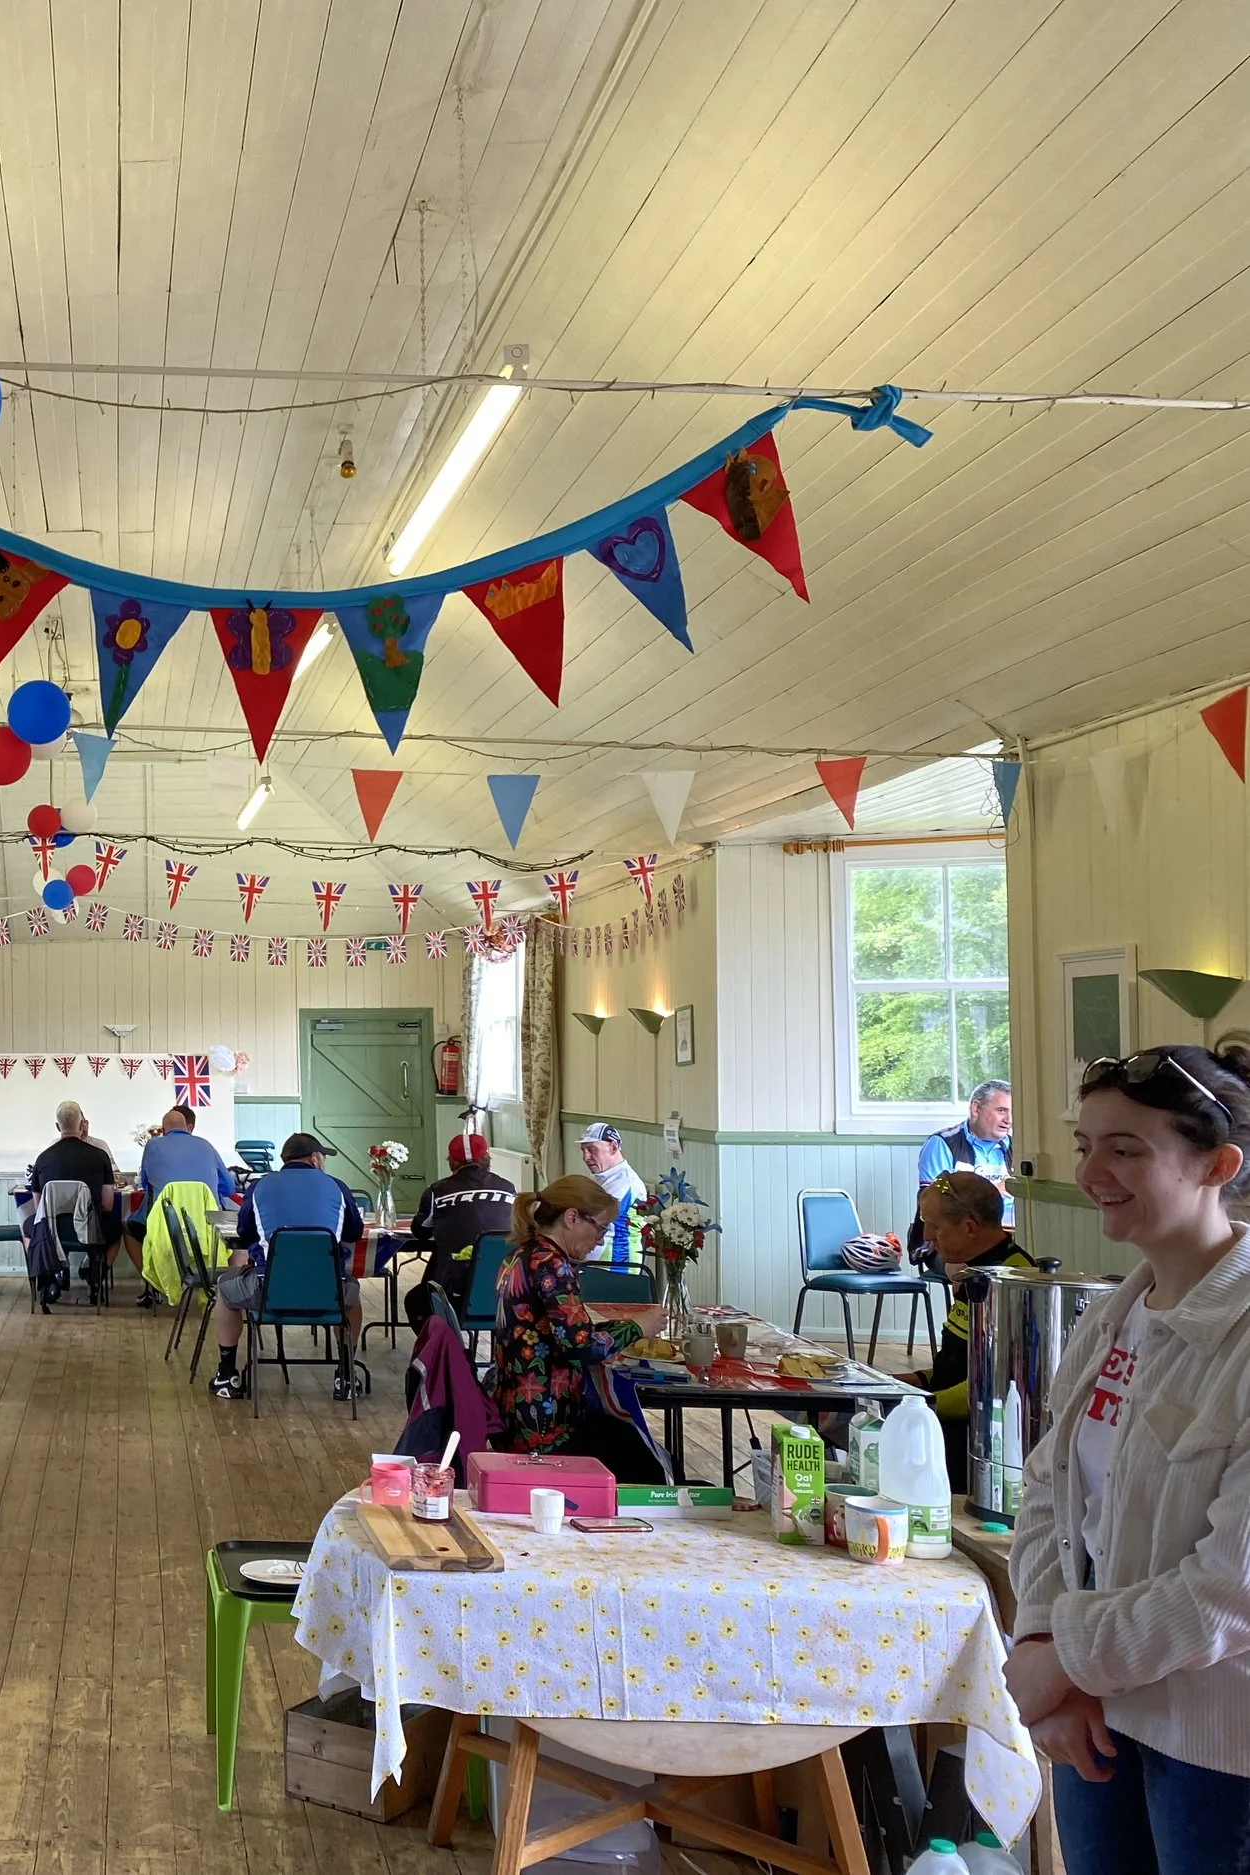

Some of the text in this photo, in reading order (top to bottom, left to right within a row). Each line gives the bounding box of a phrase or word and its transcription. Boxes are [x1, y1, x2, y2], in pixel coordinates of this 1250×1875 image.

[434, 1190, 516, 1208] SCOT
[787, 1444, 820, 1460] RUDE
[787, 1460, 820, 1472] HEALTH
[795, 1473, 813, 1482] Oat
